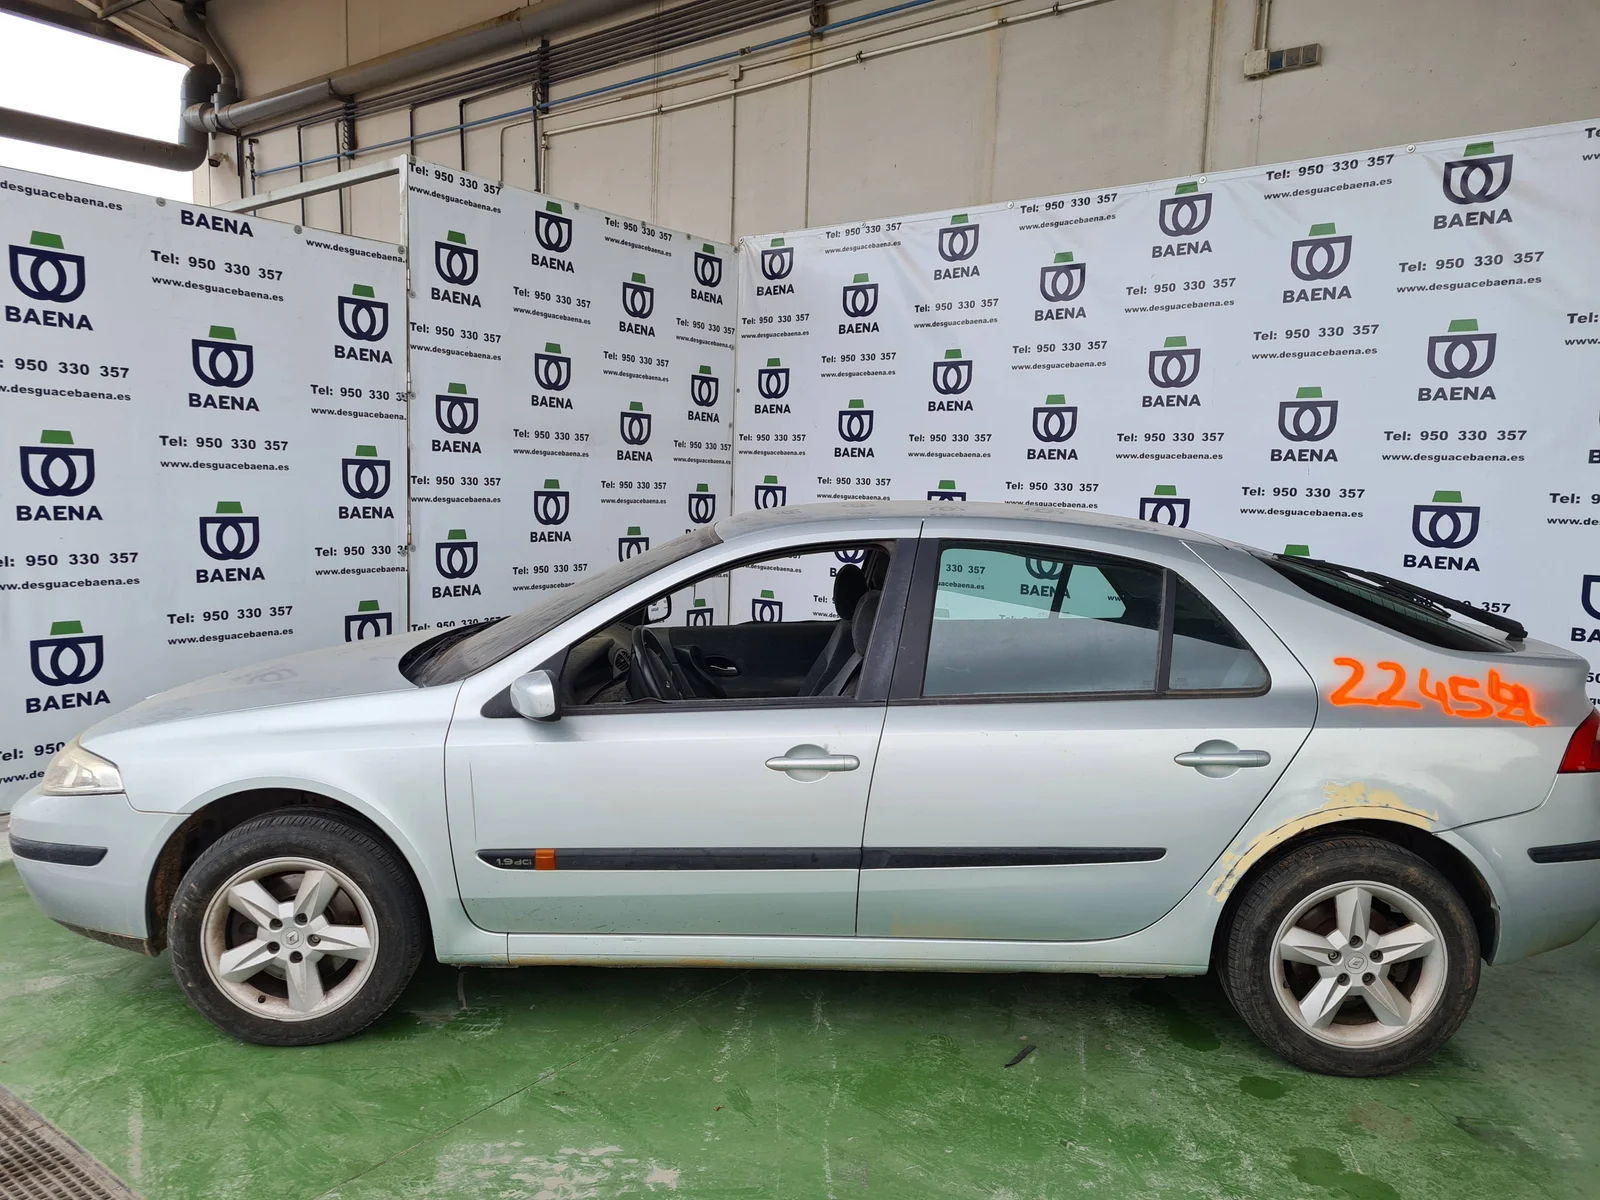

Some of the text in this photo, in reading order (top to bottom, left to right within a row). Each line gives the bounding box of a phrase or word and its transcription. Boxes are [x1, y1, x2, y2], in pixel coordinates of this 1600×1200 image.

[1266, 154, 1396, 180] Tel: 950 330 357
[409, 163, 502, 196] Tel: 950 330 357
[1264, 179, 1392, 200] www.desguacebaena.es
[408, 185, 502, 213] www.desguacebaena.es
[1020, 193, 1117, 214] Tel: 950 330 357
[181, 210, 254, 237] BAENA
[1019, 214, 1116, 230] www.desguacebaena.es
[1434, 209, 1512, 229] BAENA
[1152, 240, 1212, 258] BAENA
[150, 250, 283, 281] Tel: 950 330 357
[532, 253, 574, 273] BAENA
[1399, 251, 1544, 272] Tel: 950 330 357
[934, 265, 980, 280] BAENA
[152, 277, 284, 302] www.desguacebaena.es
[757, 284, 794, 296] BAENA
[1126, 278, 1236, 295] Tel: 950 330 357
[1397, 277, 1542, 293] www.desguacebaena.es
[431, 287, 481, 307] BAENA
[691, 289, 723, 305] BAENA
[1283, 286, 1352, 303] BAENA
[914, 298, 999, 313] Tel: 950 330 357
[1125, 300, 1234, 313] www.desguacebaena.es
[5, 305, 94, 331] BAENA
[513, 307, 591, 325] www.desguacebaena.es
[759, 316, 773, 324] 950
[778, 315, 791, 323] 330
[796, 313, 810, 321] 357
[1035, 307, 1086, 321] BAENA
[619, 321, 655, 337] BAENA
[839, 322, 879, 334] BAENA
[914, 318, 998, 328] www.desguacebaena.es
[410, 322, 501, 343] Tel: 950 330 357
[1253, 324, 1379, 341] Tel: 950 330 357
[334, 345, 393, 364] BAENA
[410, 342, 502, 361] www.desguacebaena.es
[1012, 341, 1107, 354] Tel: 950 330 357
[1252, 348, 1377, 359] www.desguacebaena.es
[821, 352, 896, 363] Tel: 950 330 357
[15, 358, 48, 372] 950
[58, 362, 90, 375] 330
[100, 366, 129, 378] 357
[1011, 361, 1106, 370] www.desguacebaena.es
[821, 370, 896, 378] www.desguacebaena.es
[1142, 394, 1201, 407] BAENA
[1418, 386, 1496, 401] BAENA
[188, 393, 260, 412] BAENA
[531, 395, 573, 409] BAENA
[755, 404, 791, 414] BAENA
[928, 400, 973, 411] BAENA
[688, 410, 719, 423] BAENA
[513, 429, 589, 442] Tel: 950 330 357
[909, 434, 992, 442] Tel: 950 330 357
[1117, 432, 1224, 442] Tel: 950 330 357
[1384, 430, 1527, 441] Tel: 950 330 357
[159, 435, 288, 451] Tel: 950 330 357
[432, 440, 482, 453] BAENA
[513, 449, 589, 457] www.desguacebaena.es
[617, 450, 653, 462] BAENA
[834, 447, 874, 458] BAENA
[908, 451, 991, 459] www.desguacebaena.es
[1027, 449, 1078, 460] BAENA
[1116, 452, 1223, 461] www.desguacebaena.es
[1271, 449, 1338, 462] BAENA
[1382, 453, 1525, 463] www.desguacebaena.es
[160, 461, 289, 471] www.desguacebaena.es
[411, 476, 501, 486] Tel: 950 330 357
[836, 477, 851, 485] 950
[876, 478, 891, 486] 357
[1242, 487, 1365, 498] Tel: 950 330 357
[411, 495, 502, 505] www.desguacebaena.es
[16, 505, 103, 521] BAENA
[339, 506, 394, 519] BAENA
[1240, 508, 1363, 518] www.desguacebaena.es
[530, 531, 571, 542] BAENA
[25, 552, 138, 566] 950 330 357
[1403, 554, 1480, 571] BAENA
[196, 567, 265, 583] BAENA
[512, 563, 588, 575] Tel: 950 330 357
[946, 564, 986, 575] 330 357
[432, 584, 481, 598] BAENA
[167, 606, 293, 624] Tel: 950 330 357
[167, 629, 293, 645] www.desguacebaena.es
[26, 690, 111, 713] BAENA
